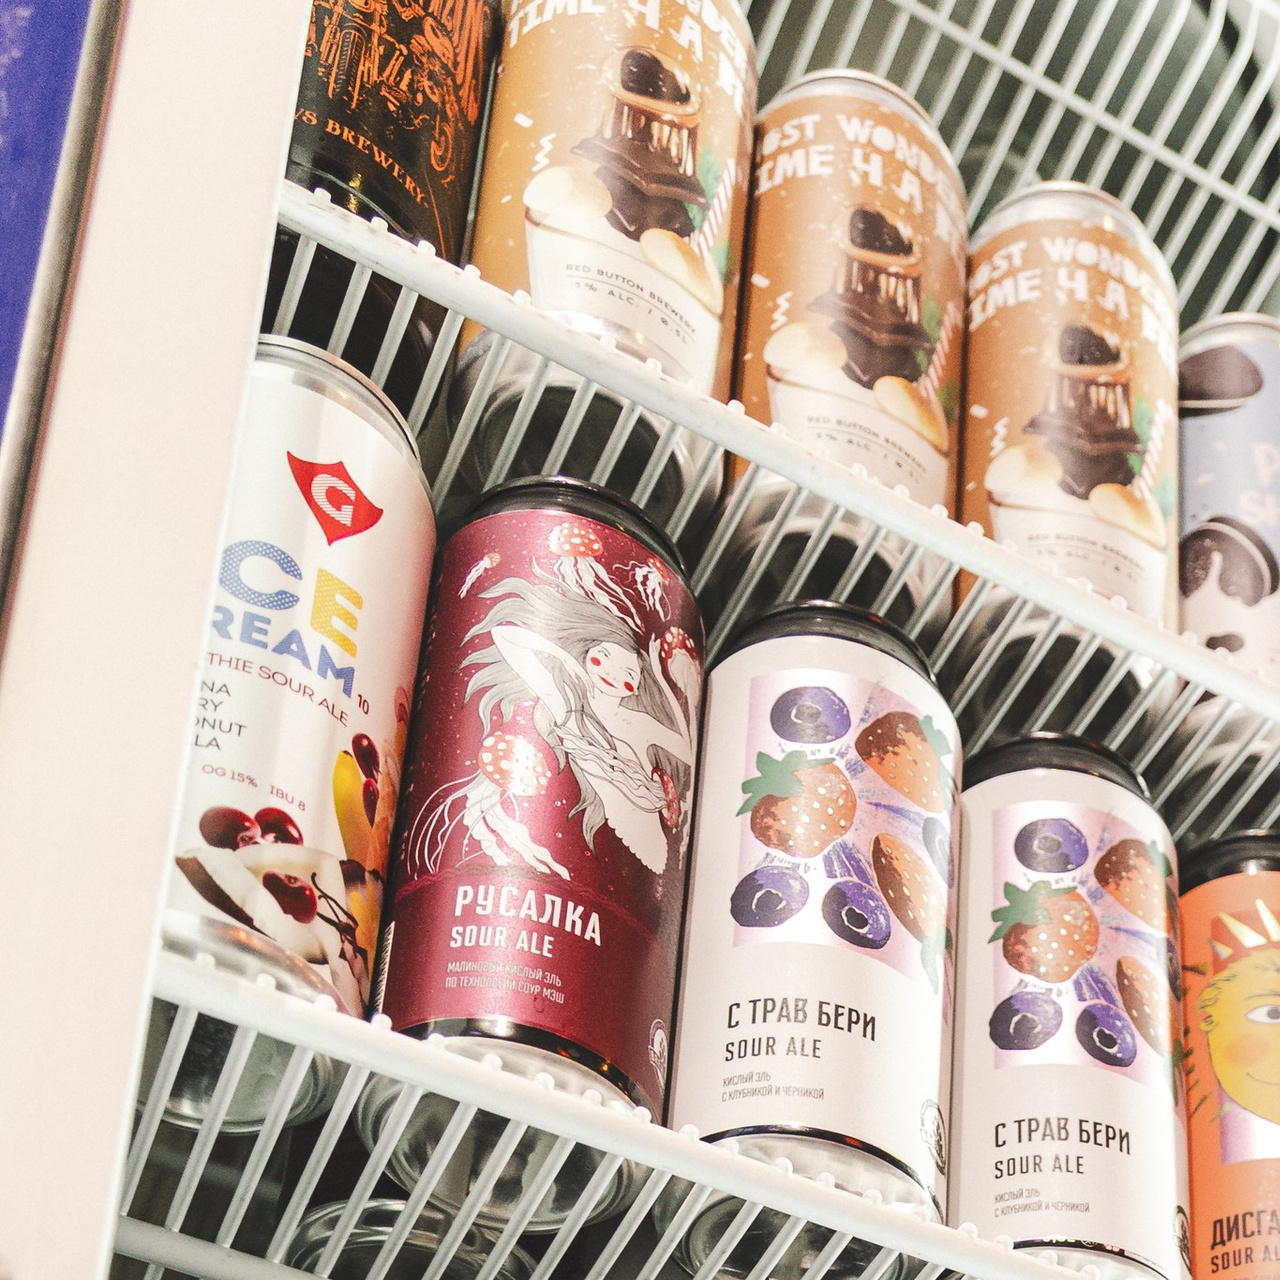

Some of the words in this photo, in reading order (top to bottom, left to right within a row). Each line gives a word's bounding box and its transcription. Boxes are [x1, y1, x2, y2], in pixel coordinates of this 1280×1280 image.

[669, 15, 703, 61] A
[757, 114, 821, 165] OST
[325, 118, 425, 205] BREWERY
[850, 147, 883, 187] 4
[892, 169, 924, 214] A
[566, 264, 591, 273] RED
[597, 269, 644, 292] BUTTON
[969, 240, 1027, 297] OST
[1055, 267, 1090, 302] 4
[1097, 279, 1130, 321] A
[258, 664, 315, 702] SOUR
[319, 700, 350, 727] ALE
[202, 764, 226, 777] OG
[230, 770, 258, 788] 15%
[270, 784, 295, 804] IBU
[454, 884, 601, 946] РУСАЛКА
[450, 925, 507, 948] SOUR
[516, 930, 555, 958] ALE
[445, 977, 457, 988] ПО
[518, 982, 540, 995] СОУР
[543, 988, 565, 1004] МЭШ
[544, 972, 562, 987] ЭЛЬ
[727, 1003, 740, 1029] С
[749, 998, 808, 1025] ТРАВ
[818, 1000, 876, 1041] БЕРИ
[725, 1036, 776, 1062] SOUR
[786, 1036, 822, 1059] ALE
[723, 1072, 754, 1087] КИСЛЫЙ
[755, 1072, 771, 1082] ЭЛЬ
[729, 1084, 772, 1100] КЛУБНИКОЙ
[775, 1086, 780, 1095] И
[783, 1086, 824, 1100] ЧЕРНИКОЙ
[995, 1123, 1006, 1147] С
[1014, 1117, 1069, 1143] ТРАВ
[1079, 1119, 1130, 1155] БЕРИ
[995, 1155, 1042, 1179] SOUR
[1052, 1154, 1084, 1174] ALE
[1211, 1247, 1254, 1274] SOUR
